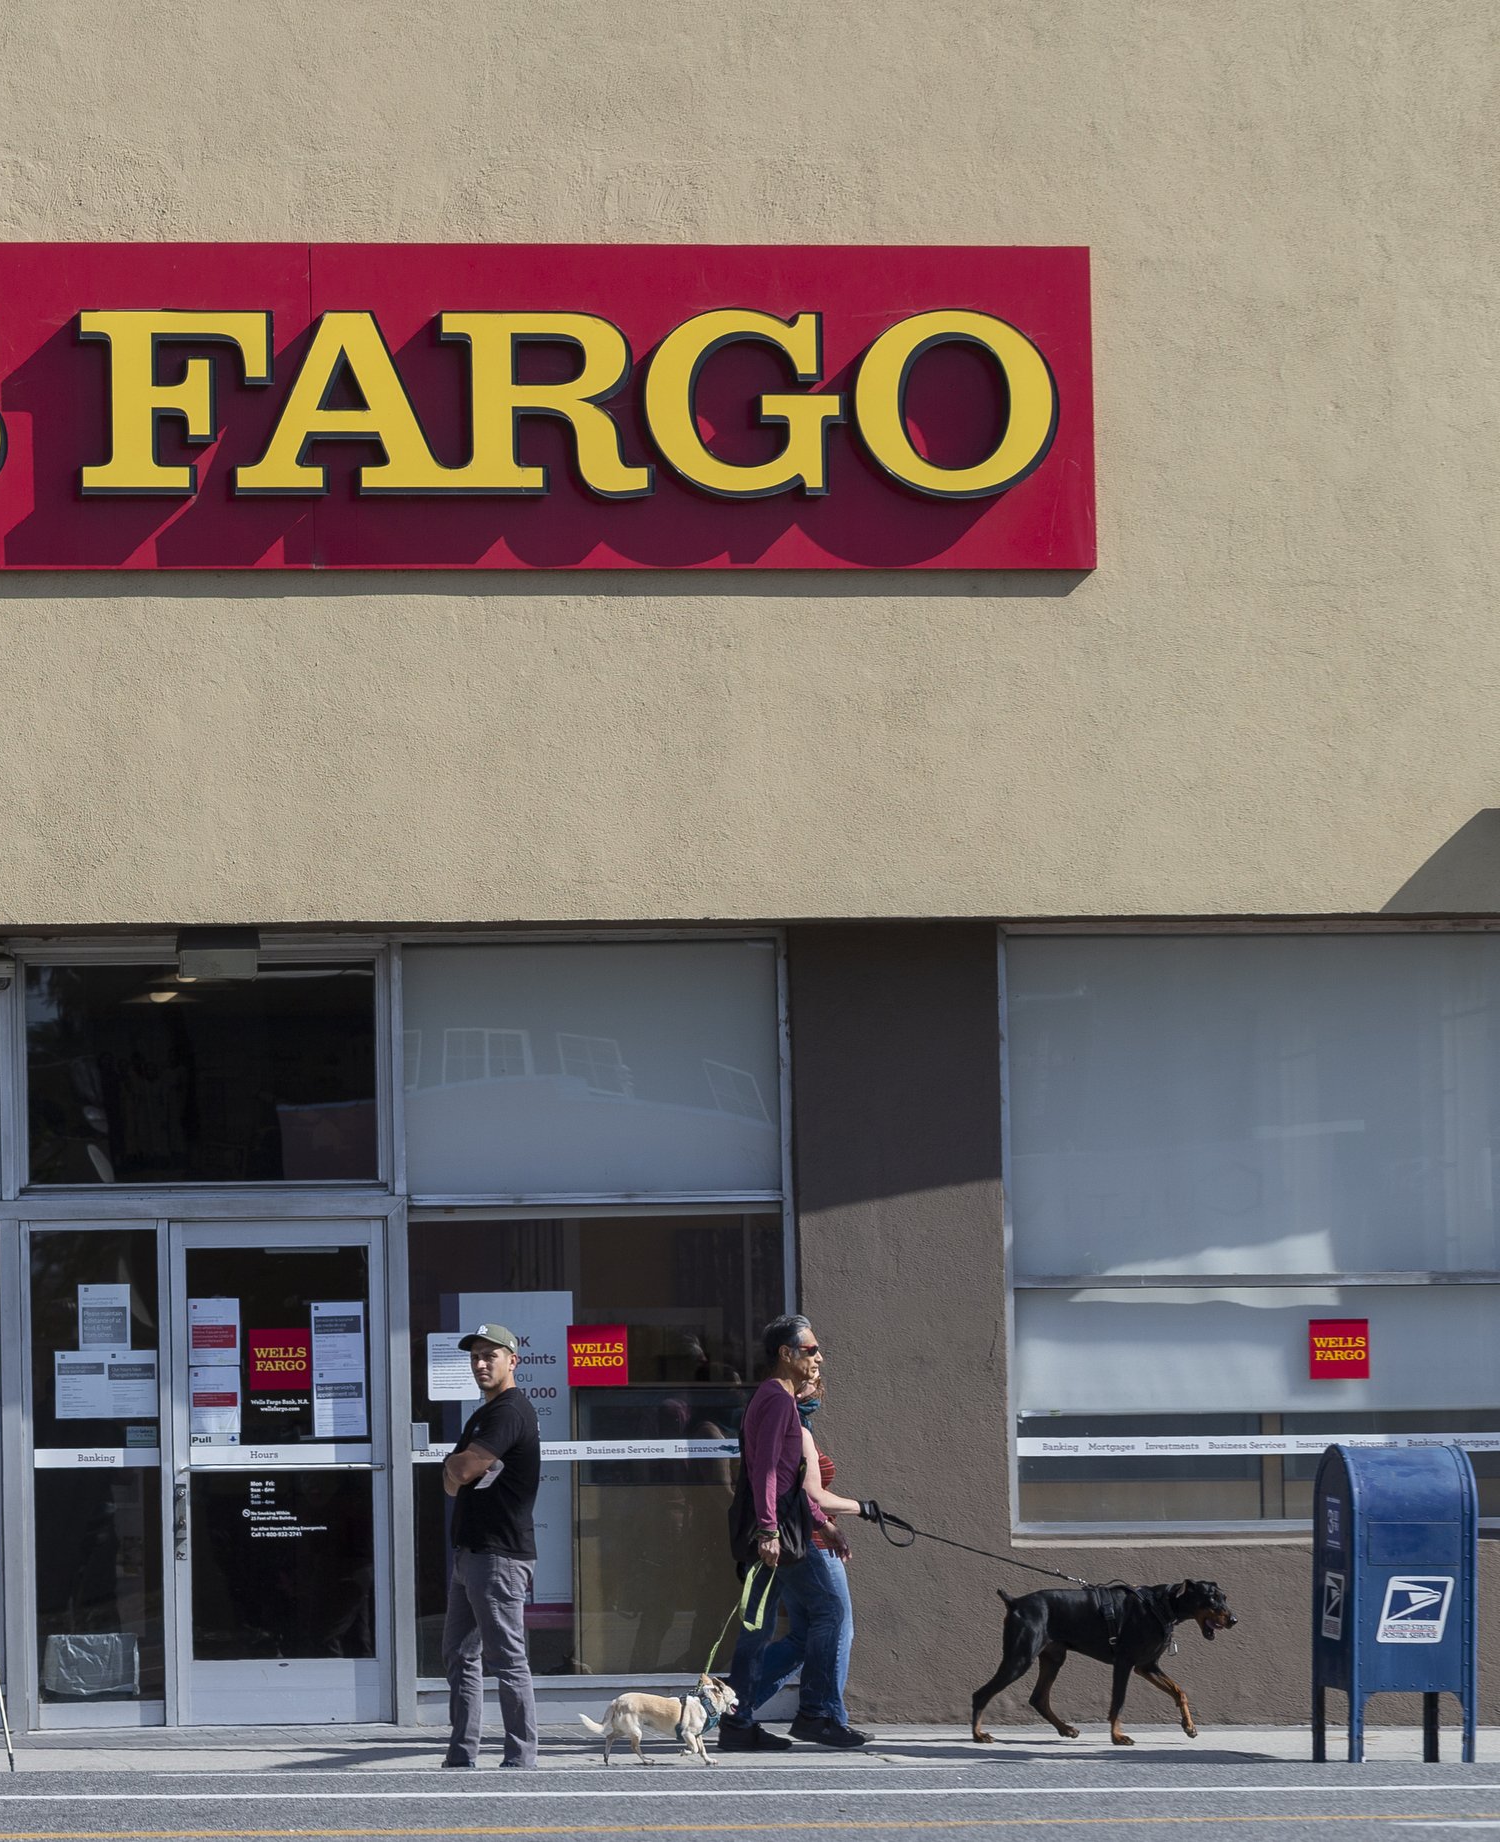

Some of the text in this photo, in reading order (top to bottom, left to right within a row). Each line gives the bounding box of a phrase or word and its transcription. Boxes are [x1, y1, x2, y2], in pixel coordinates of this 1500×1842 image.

[80, 308, 1057, 497] FARGO
[571, 1342, 625, 1354] WELLS
[1313, 1336, 1367, 1348] WELLS
[253, 1347, 307, 1358] WELLS
[1315, 1349, 1366, 1361] FARGO
[255, 1360, 307, 1372] FARGO
[573, 1356, 625, 1368] FARGO
[586, 1446, 625, 1454] Business
[627, 1445, 664, 1454] Services
[674, 1445, 718, 1453] Insurance
[1043, 1443, 1079, 1453] Banking
[1088, 1442, 1136, 1452] Mortgages
[1145, 1441, 1199, 1450] Investments
[1208, 1440, 1247, 1450] Business
[1249, 1440, 1287, 1449] Services
[1295, 1440, 1339, 1449] Insuran
[1452, 1437, 1500, 1447] Mortgages
[77, 1454, 115, 1463] Banking
[250, 1450, 278, 1459] Hours
